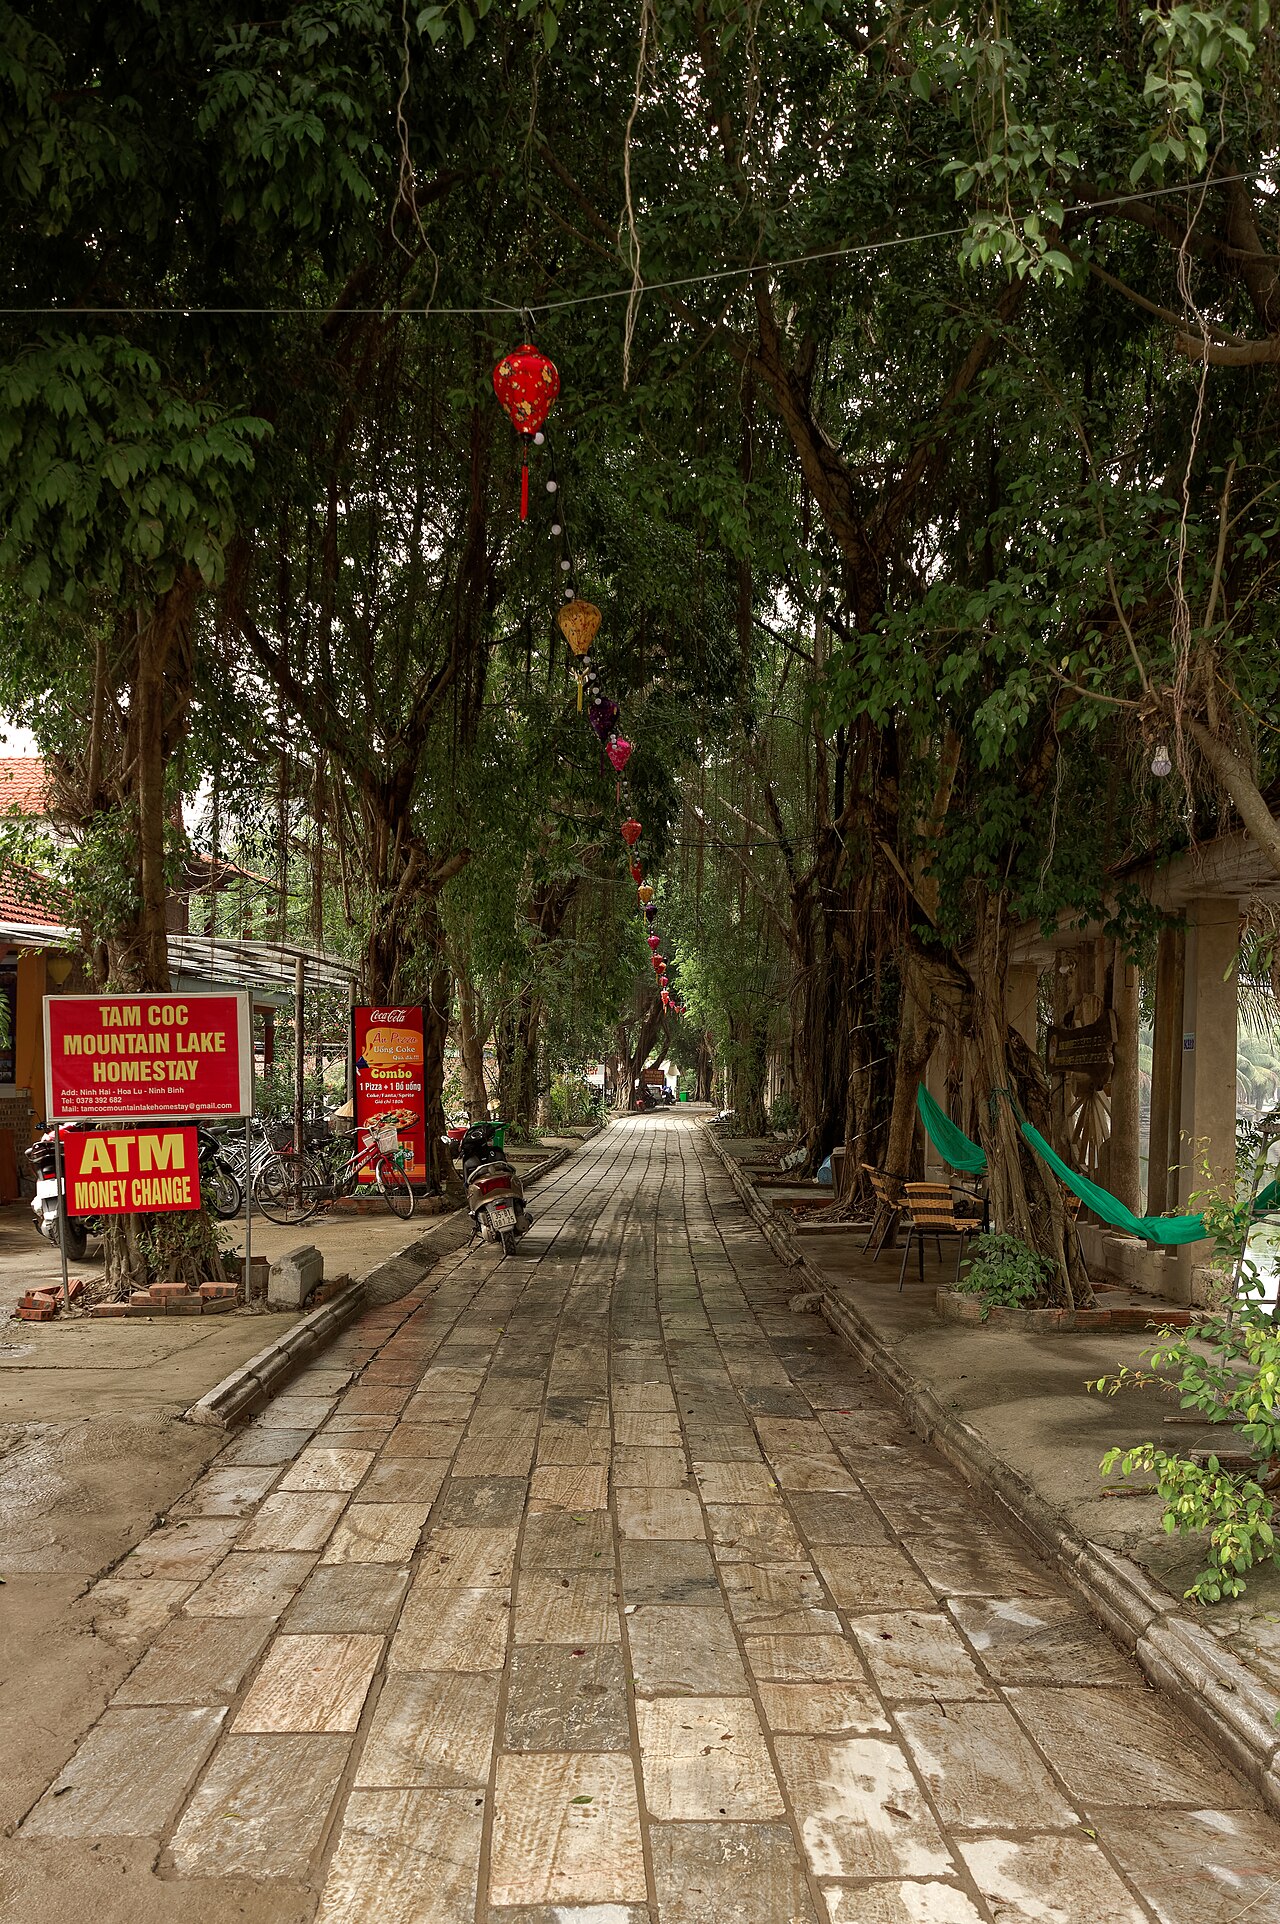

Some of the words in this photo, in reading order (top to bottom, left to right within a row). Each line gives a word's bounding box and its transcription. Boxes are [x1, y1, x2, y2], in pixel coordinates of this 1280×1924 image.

[99, 1006, 141, 1027] TAM
[147, 1005, 189, 1026] COC
[63, 1033, 170, 1055] MOUNTAIN
[176, 1032, 226, 1053] LAKE
[390, 1031, 417, 1044] Pizza
[395, 1045, 416, 1053] Coke
[93, 1060, 198, 1083] HOMESTAY
[371, 1068, 413, 1079] Combo
[360, 1082, 364, 1091] 1
[365, 1082, 383, 1091] Pizza
[390, 1082, 394, 1091] 1
[79, 1133, 186, 1175] ATM
[74, 1180, 128, 1210] MONEY
[131, 1176, 193, 1206] CHANGE
